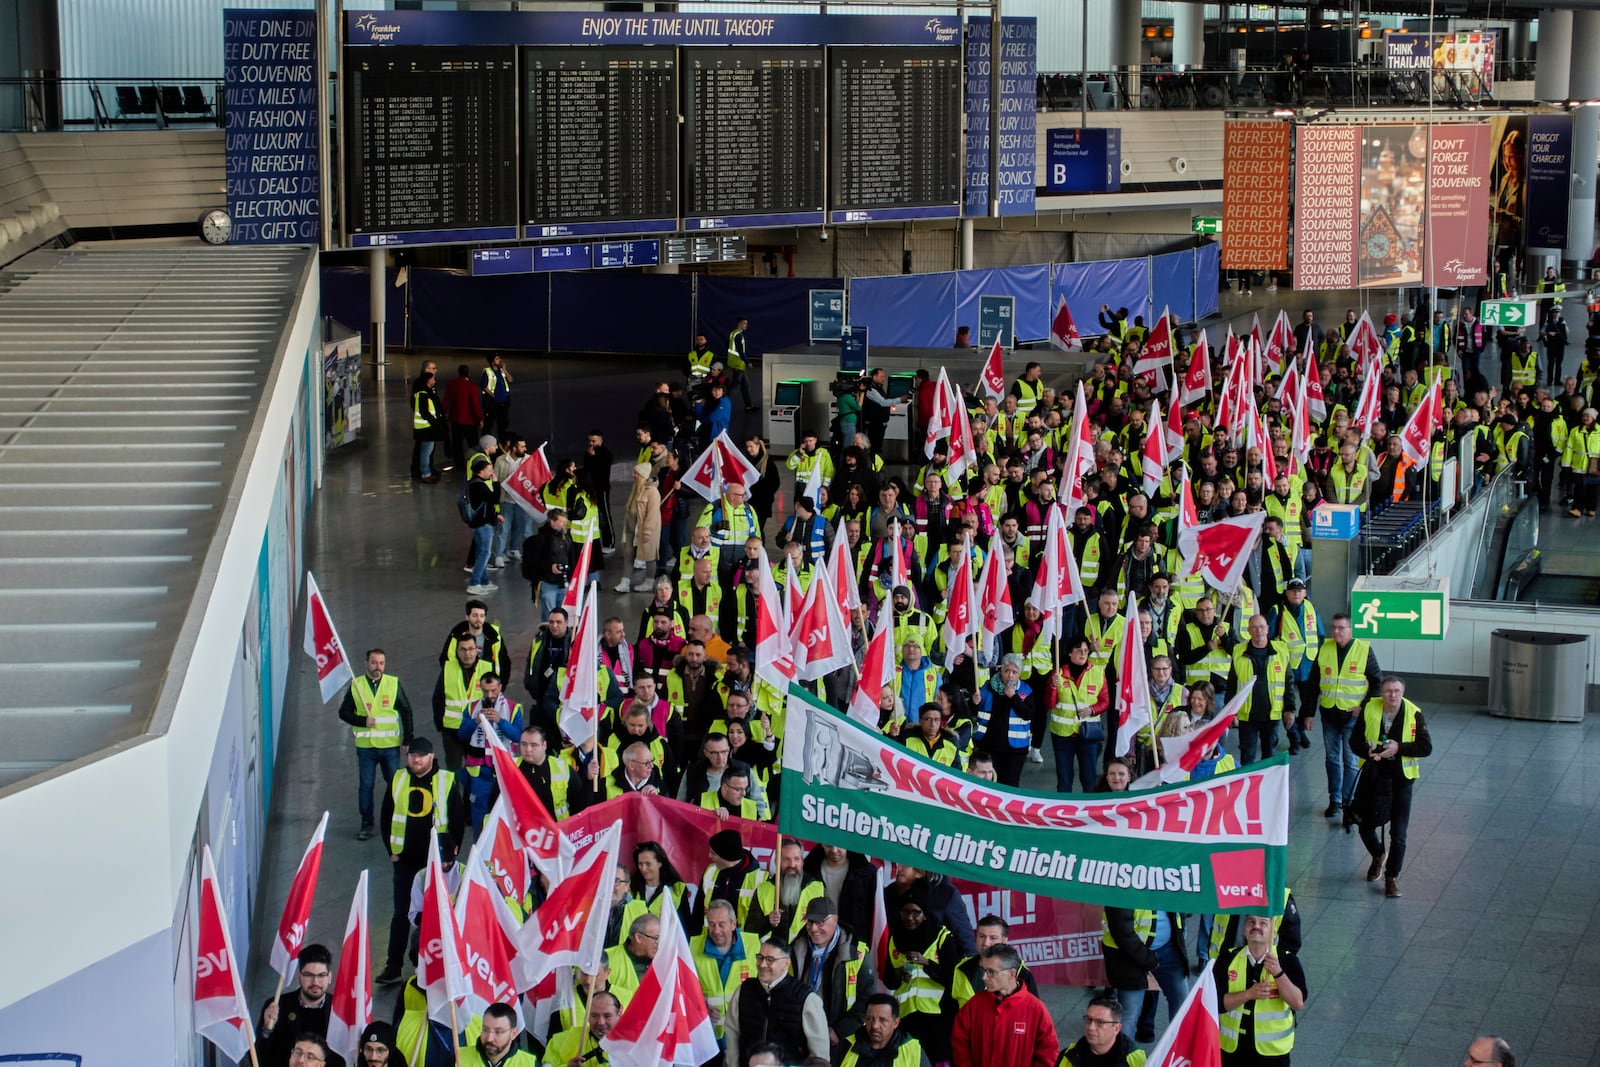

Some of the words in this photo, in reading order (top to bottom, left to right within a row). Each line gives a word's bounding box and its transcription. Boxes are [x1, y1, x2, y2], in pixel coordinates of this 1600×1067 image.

[260, 20, 293, 37] DINE
[582, 19, 621, 39] ENJOY
[625, 19, 649, 36] THE
[653, 19, 682, 36] TIME
[686, 19, 720, 36] UNTIL
[725, 19, 774, 36] TAKEOFF
[370, 33, 393, 41] Airport
[242, 43, 279, 60] DUTY
[281, 43, 310, 60] FREE
[1006, 43, 1026, 57] FREE
[1389, 44, 1413, 55] THINK
[1388, 56, 1432, 68] THAILAND
[239, 65, 312, 82] SOUVENIRS
[258, 88, 296, 104] MILES
[248, 110, 306, 128] FASHION
[253, 132, 303, 150] LUXURY
[1228, 130, 1285, 144] REFRESH
[1303, 130, 1355, 140] SOUVENIRS
[1532, 133, 1560, 142] FORGOT
[1303, 141, 1355, 152] SOUVENIRS
[1433, 139, 1465, 150] DON'T
[1532, 144, 1550, 153] YOUR
[1228, 146, 1285, 159] REFRESH
[1303, 152, 1354, 163] SOUVENIRS
[1432, 152, 1469, 162] FORGET
[251, 155, 305, 173] REFRESH
[967, 154, 986, 168] EALS
[1531, 155, 1565, 163] CHARGER?
[1228, 160, 1284, 173] REFRESH
[1302, 164, 1354, 174] SOUVENIRS
[1432, 165, 1445, 175] TO
[1448, 165, 1469, 174] TAKE
[1054, 164, 1066, 184] B
[1302, 175, 1354, 185] SOUVENIRS
[227, 178, 256, 196] EALS
[258, 177, 298, 195] DEALS
[1227, 175, 1284, 188] REFRESH
[1432, 177, 1482, 188] SOUVENIRS
[1227, 190, 1284, 203] REFRESH
[1302, 186, 1353, 196] SOUVENIRS
[1302, 197, 1353, 208] SOUVENIRS
[1227, 205, 1283, 218] REFRESH
[1301, 208, 1353, 219] SOUVENIRS
[228, 223, 259, 240] IFTS
[261, 221, 297, 239] GIFTS
[300, 221, 319, 238] GIF
[1227, 220, 1283, 233] REFRESH
[1301, 219, 1353, 230] SOUVENIRS
[1226, 234, 1282, 247] REFRESH
[1301, 230, 1352, 241] SOUVENIRS
[566, 246, 571, 255] B
[1301, 242, 1352, 252] SOUVENIRS
[505, 250, 510, 259] C
[1226, 249, 1282, 262] REFRESH
[1300, 253, 1352, 263] SOUVENIRS
[1300, 264, 1351, 274] SOUVENIRS
[1300, 275, 1351, 286] SOUVENIRS
[880, 747, 1263, 836] WARNSTREIK!
[801, 793, 930, 856] Sicherheit
[1009, 846, 1074, 884] nicht
[1078, 858, 1201, 893] umsonst!
[1219, 882, 1263, 899] ver.di
[961, 890, 1036, 930] AHL!
